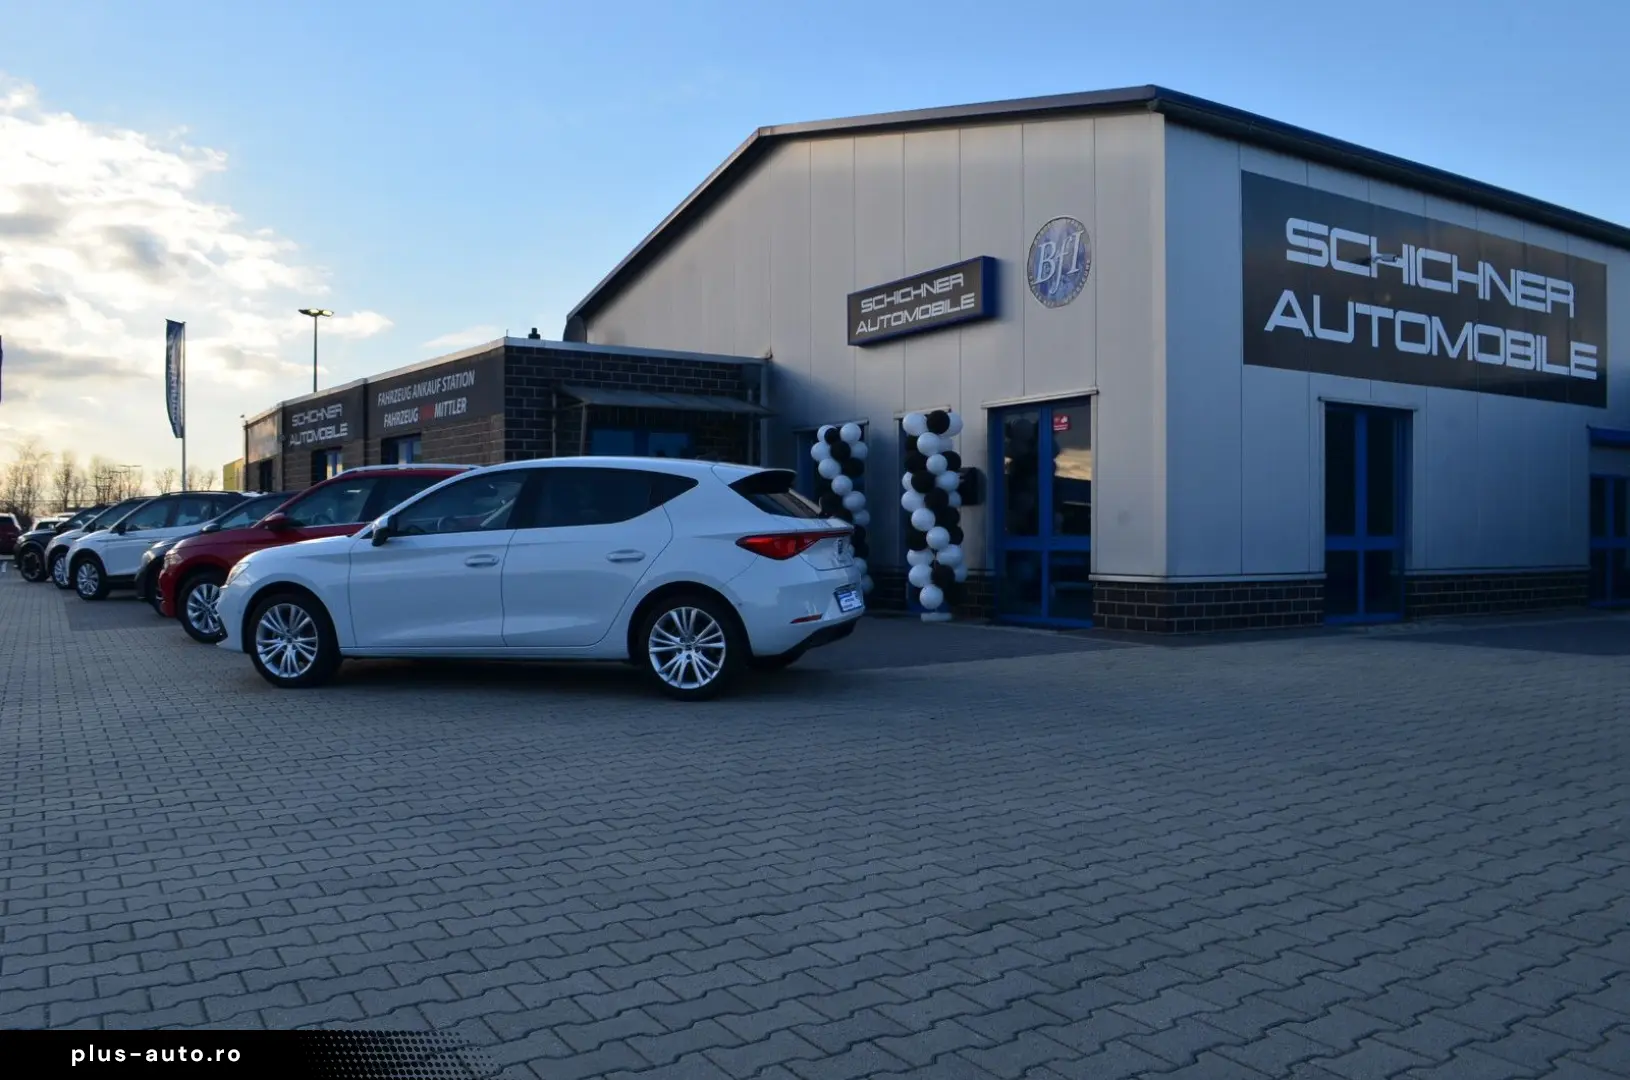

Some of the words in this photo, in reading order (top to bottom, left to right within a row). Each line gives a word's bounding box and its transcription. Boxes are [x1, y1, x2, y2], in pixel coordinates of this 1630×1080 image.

[1286, 217, 1574, 318] SCHICHNER
[861, 273, 964, 313] SCHICHNER
[856, 292, 975, 335] AUTOMOBILE
[1264, 289, 1598, 380] AUTOMOBILE
[377, 386, 412, 407] FAHRZEUG
[412, 379, 440, 399] ANKAUF
[441, 369, 476, 391] STATION
[290, 423, 348, 445] AUTOMOBILE
[293, 404, 343, 426] SCHICHNER
[384, 407, 419, 428] FAHRZEUG
